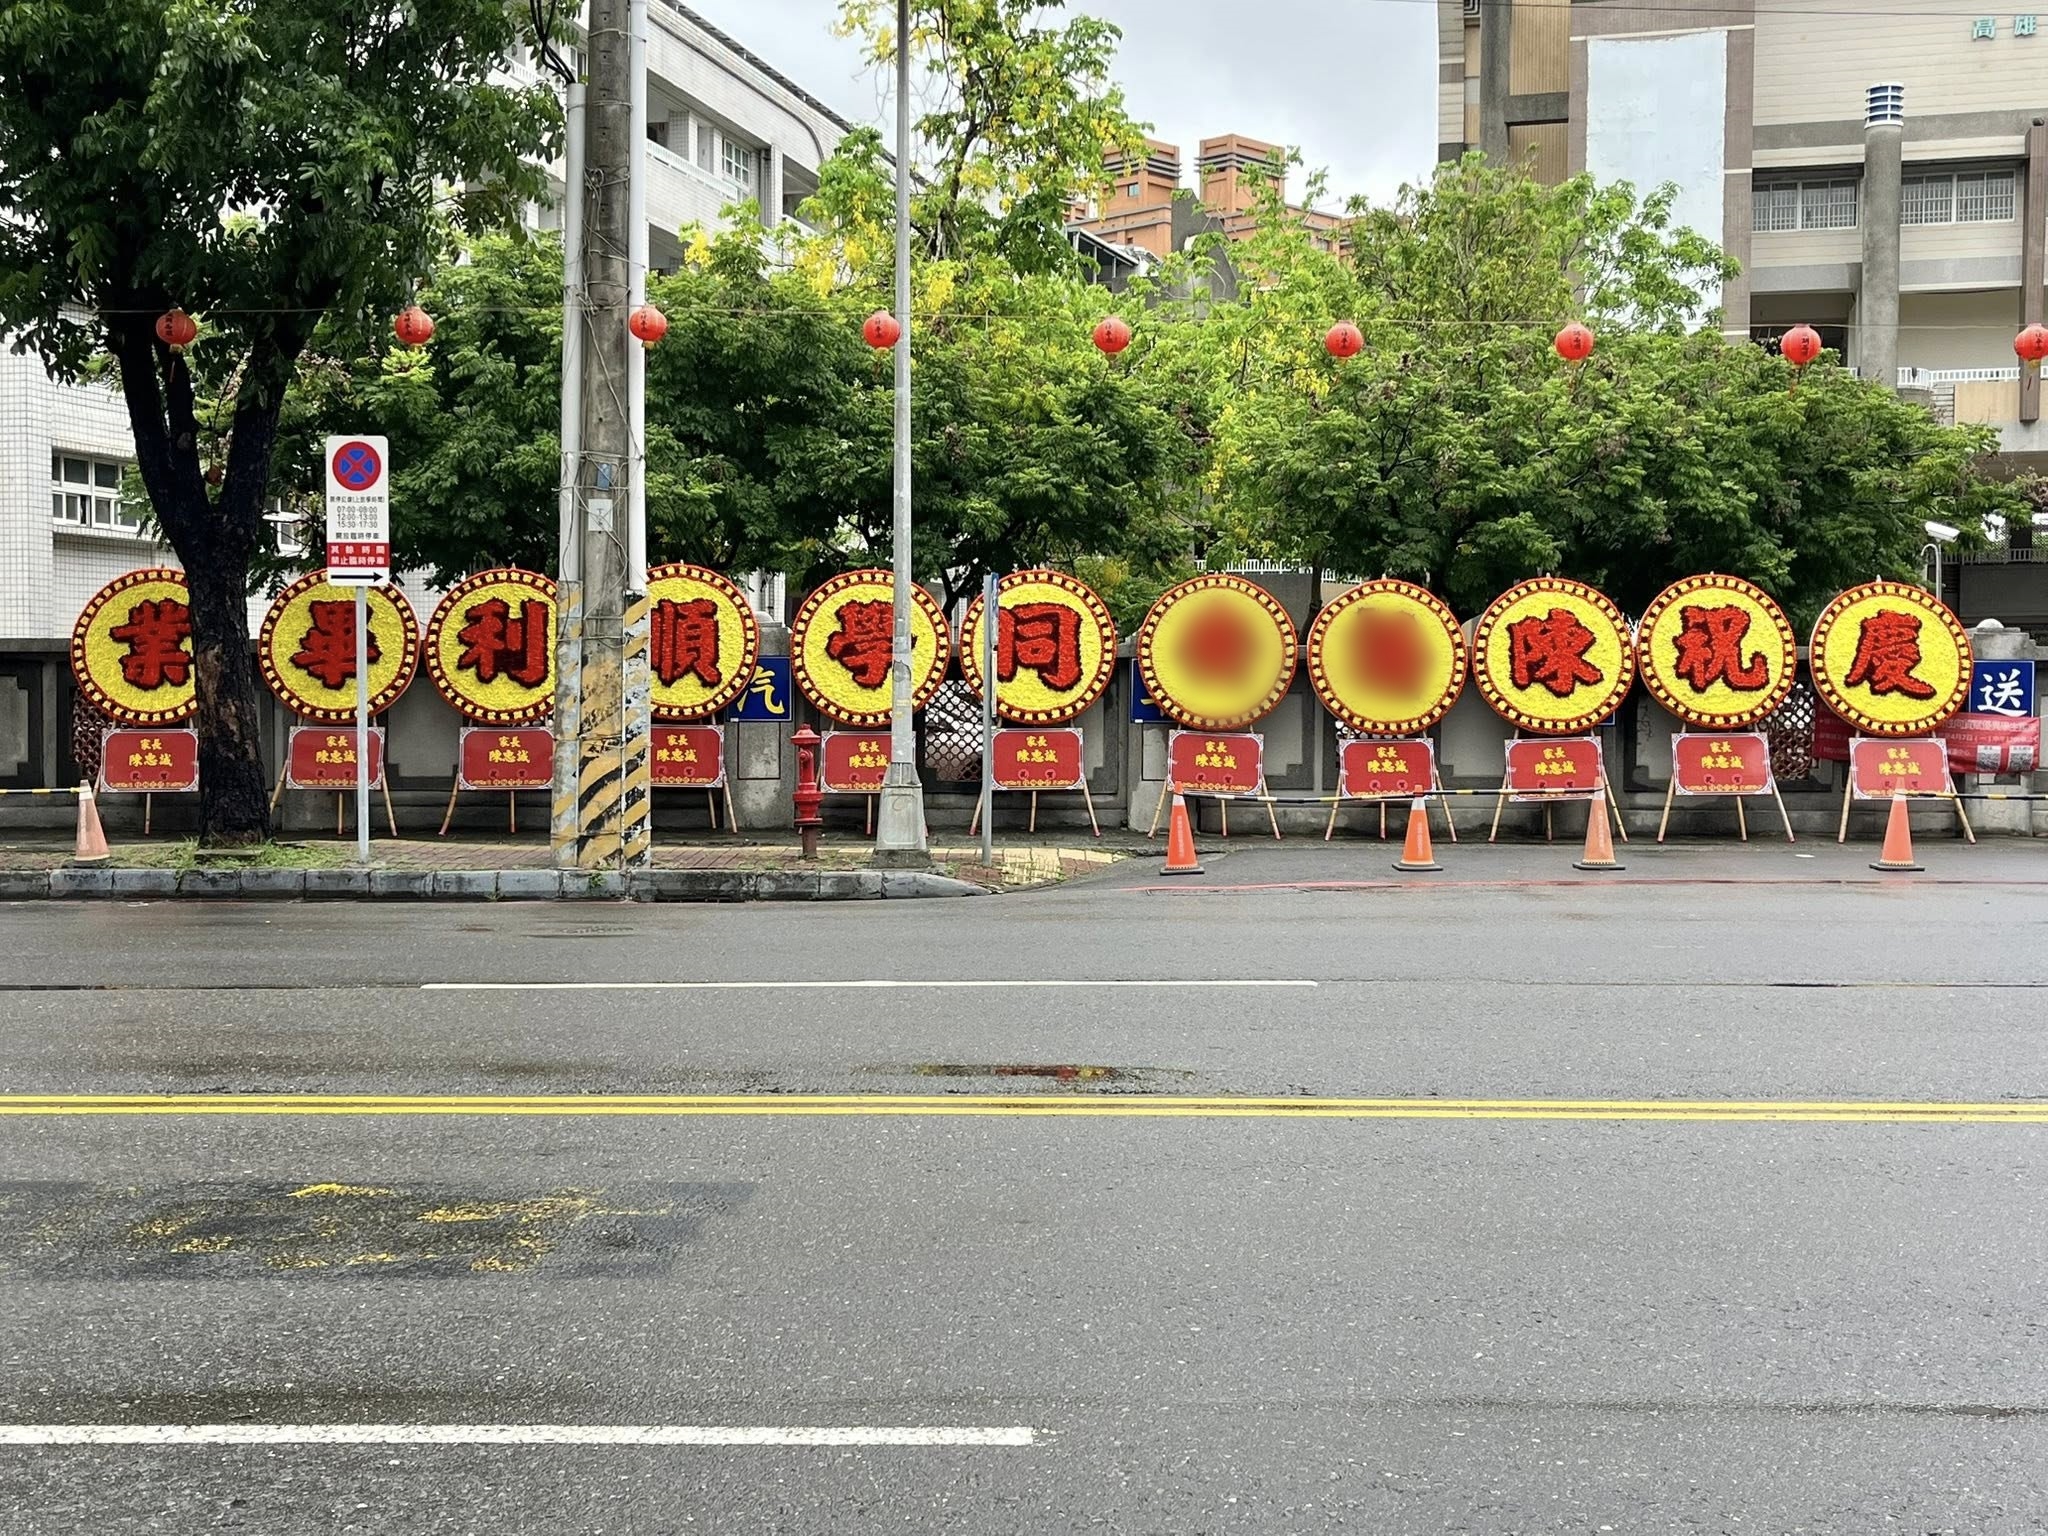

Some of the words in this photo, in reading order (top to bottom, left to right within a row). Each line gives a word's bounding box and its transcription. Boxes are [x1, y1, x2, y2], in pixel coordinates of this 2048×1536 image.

[1972, 14, 2037, 41] 高雄
[109, 600, 194, 689] 業
[291, 600, 380, 688] 畢
[458, 598, 548, 688] 利
[650, 598, 722, 688] 順
[826, 600, 916, 688] 學
[999, 601, 1082, 690] 同
[1507, 607, 1604, 697] 陳
[1673, 604, 1769, 692] 祝
[1846, 608, 1936, 699] 慶
[1976, 668, 2028, 717] 送
[140, 738, 162, 750] 家長
[327, 736, 347, 747] 家長
[498, 735, 521, 748] 家長
[667, 735, 687, 746] 家長
[859, 741, 879, 753] 家長
[1026, 735, 1047, 747] 家長
[1205, 741, 1227, 754] 家長
[1711, 741, 1731, 754] 家長
[1377, 747, 1397, 759] 家長
[1543, 747, 1565, 760] 家長
[1887, 748, 1909, 759] 家長
